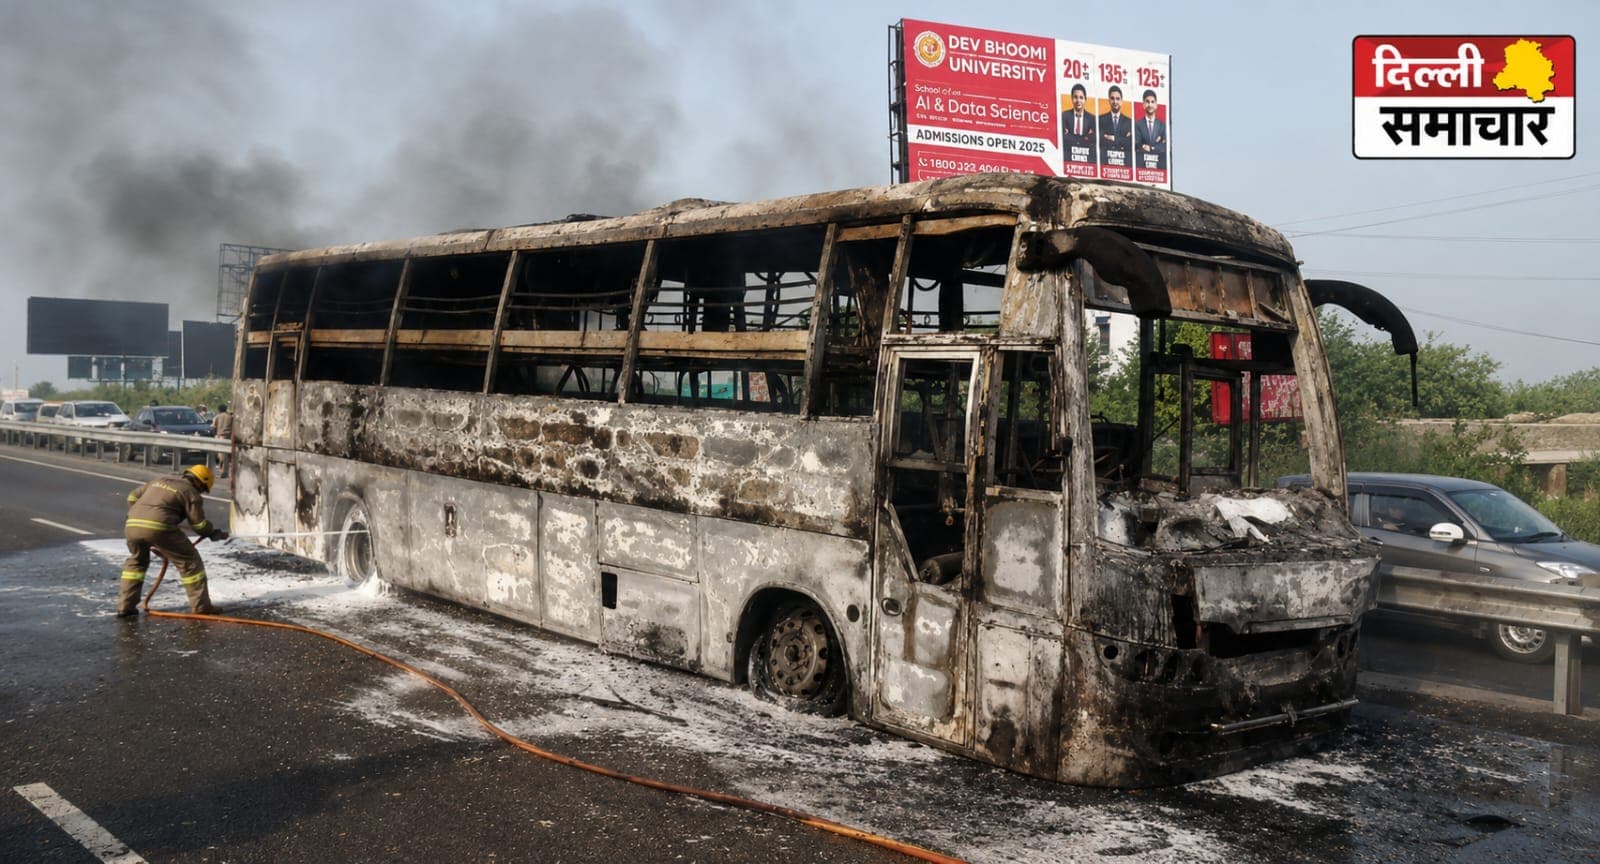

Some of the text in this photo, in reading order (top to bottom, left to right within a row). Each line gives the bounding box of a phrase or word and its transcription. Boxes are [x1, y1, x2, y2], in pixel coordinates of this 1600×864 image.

[948, 35, 1047, 60] DEV BHOOMI
[949, 57, 1046, 83] UNIVERSITY
[914, 84, 941, 95] School
[915, 95, 930, 110] AI
[934, 98, 945, 112] &
[949, 99, 986, 117] Data
[990, 103, 1049, 123] Science
[916, 129, 1046, 153] ADMISSIONS OPEN 2025
